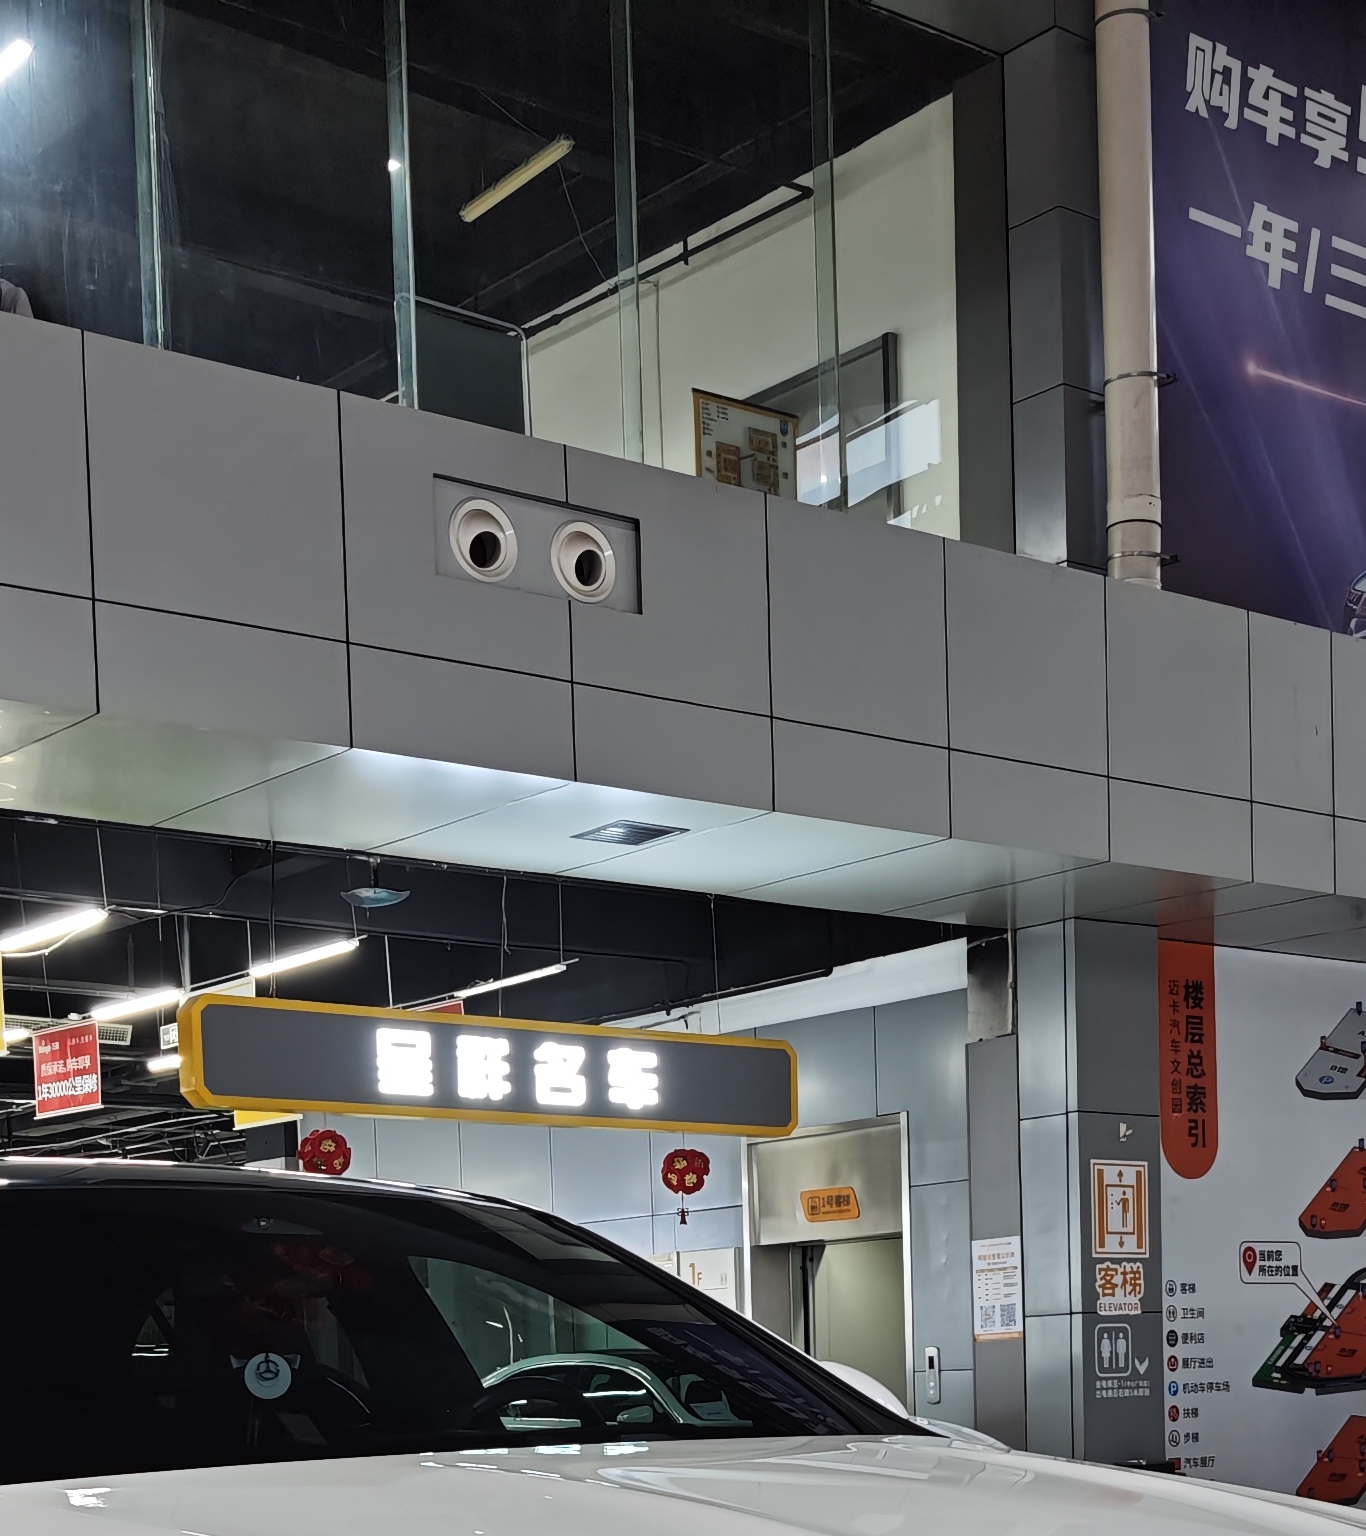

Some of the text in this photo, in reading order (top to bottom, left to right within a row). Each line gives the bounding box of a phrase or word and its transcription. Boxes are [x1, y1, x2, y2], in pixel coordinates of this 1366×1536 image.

[1169, 980, 1182, 1114] 迈卡汽车文创园
[1183, 979, 1207, 1149] 楼层总索引
[1258, 1250, 1283, 1262] 当前您
[1258, 1264, 1299, 1277] 所在的位置
[1097, 1264, 1143, 1298] 客梯
[1098, 1302, 1139, 1312] ELEVATOR
[1181, 1307, 1205, 1319] 卫生间
